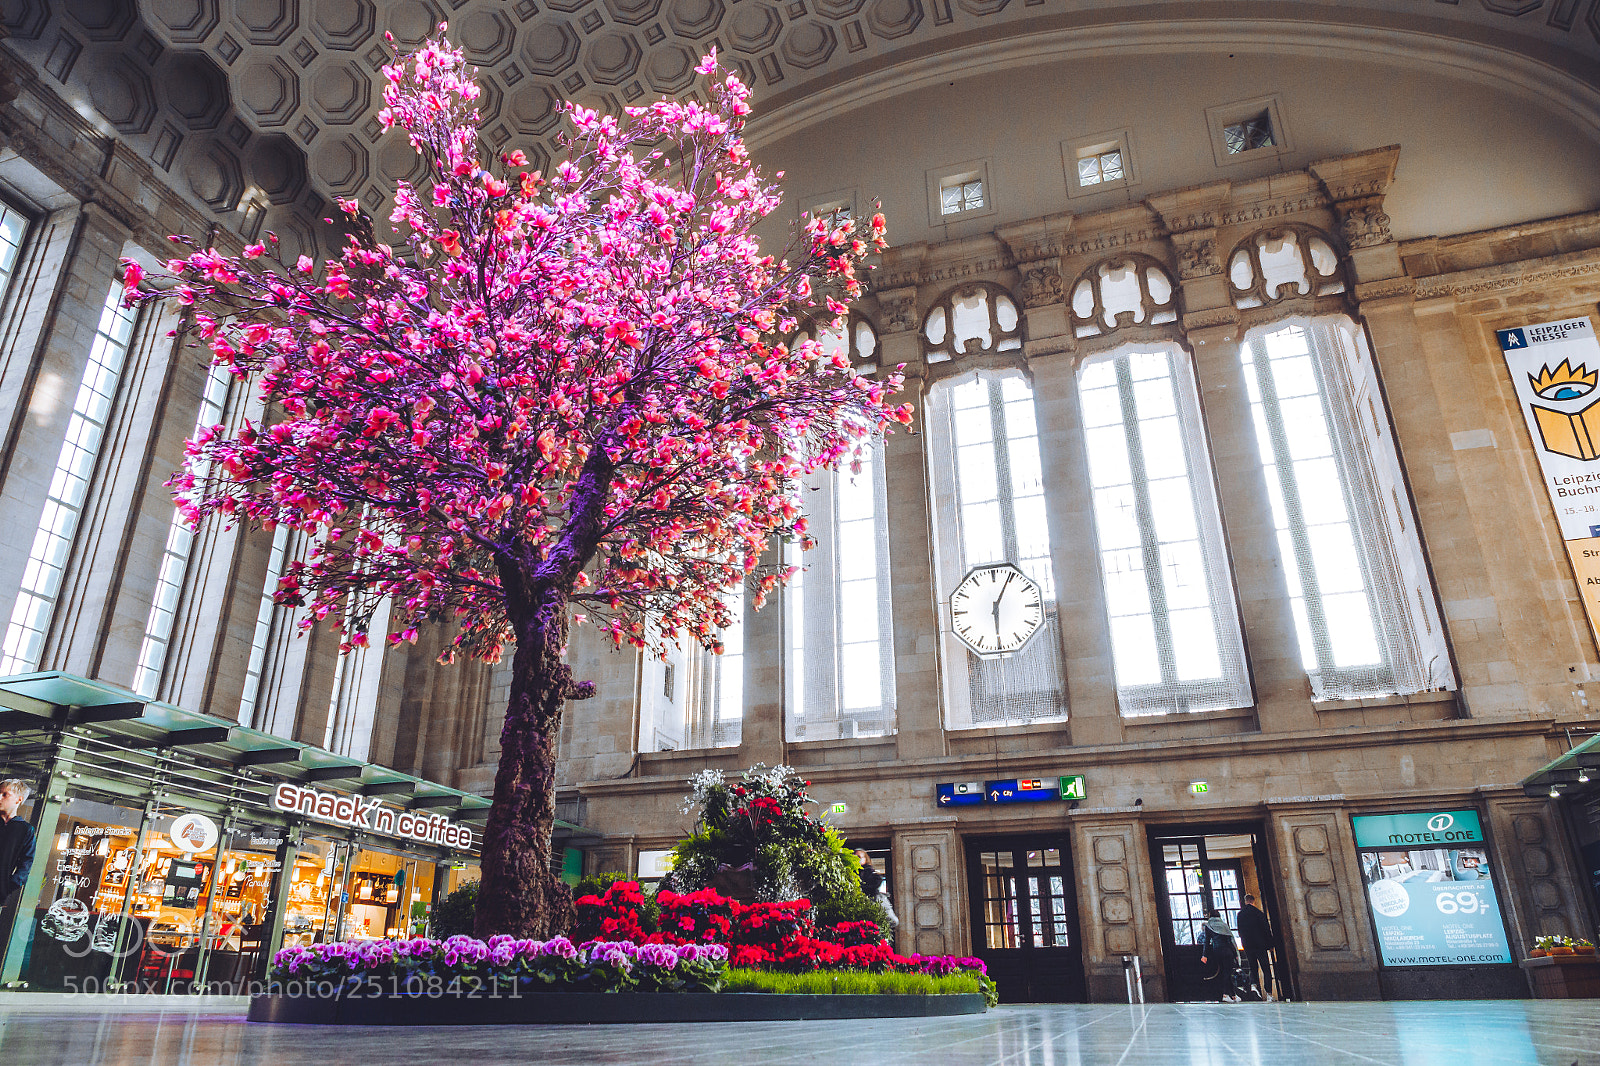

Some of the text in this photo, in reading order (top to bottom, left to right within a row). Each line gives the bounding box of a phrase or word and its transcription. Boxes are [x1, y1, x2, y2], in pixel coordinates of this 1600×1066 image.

[1529, 321, 1586, 336] LEIPZIGER
[1531, 331, 1568, 343] MESSE
[399, 814, 472, 848] coffee
